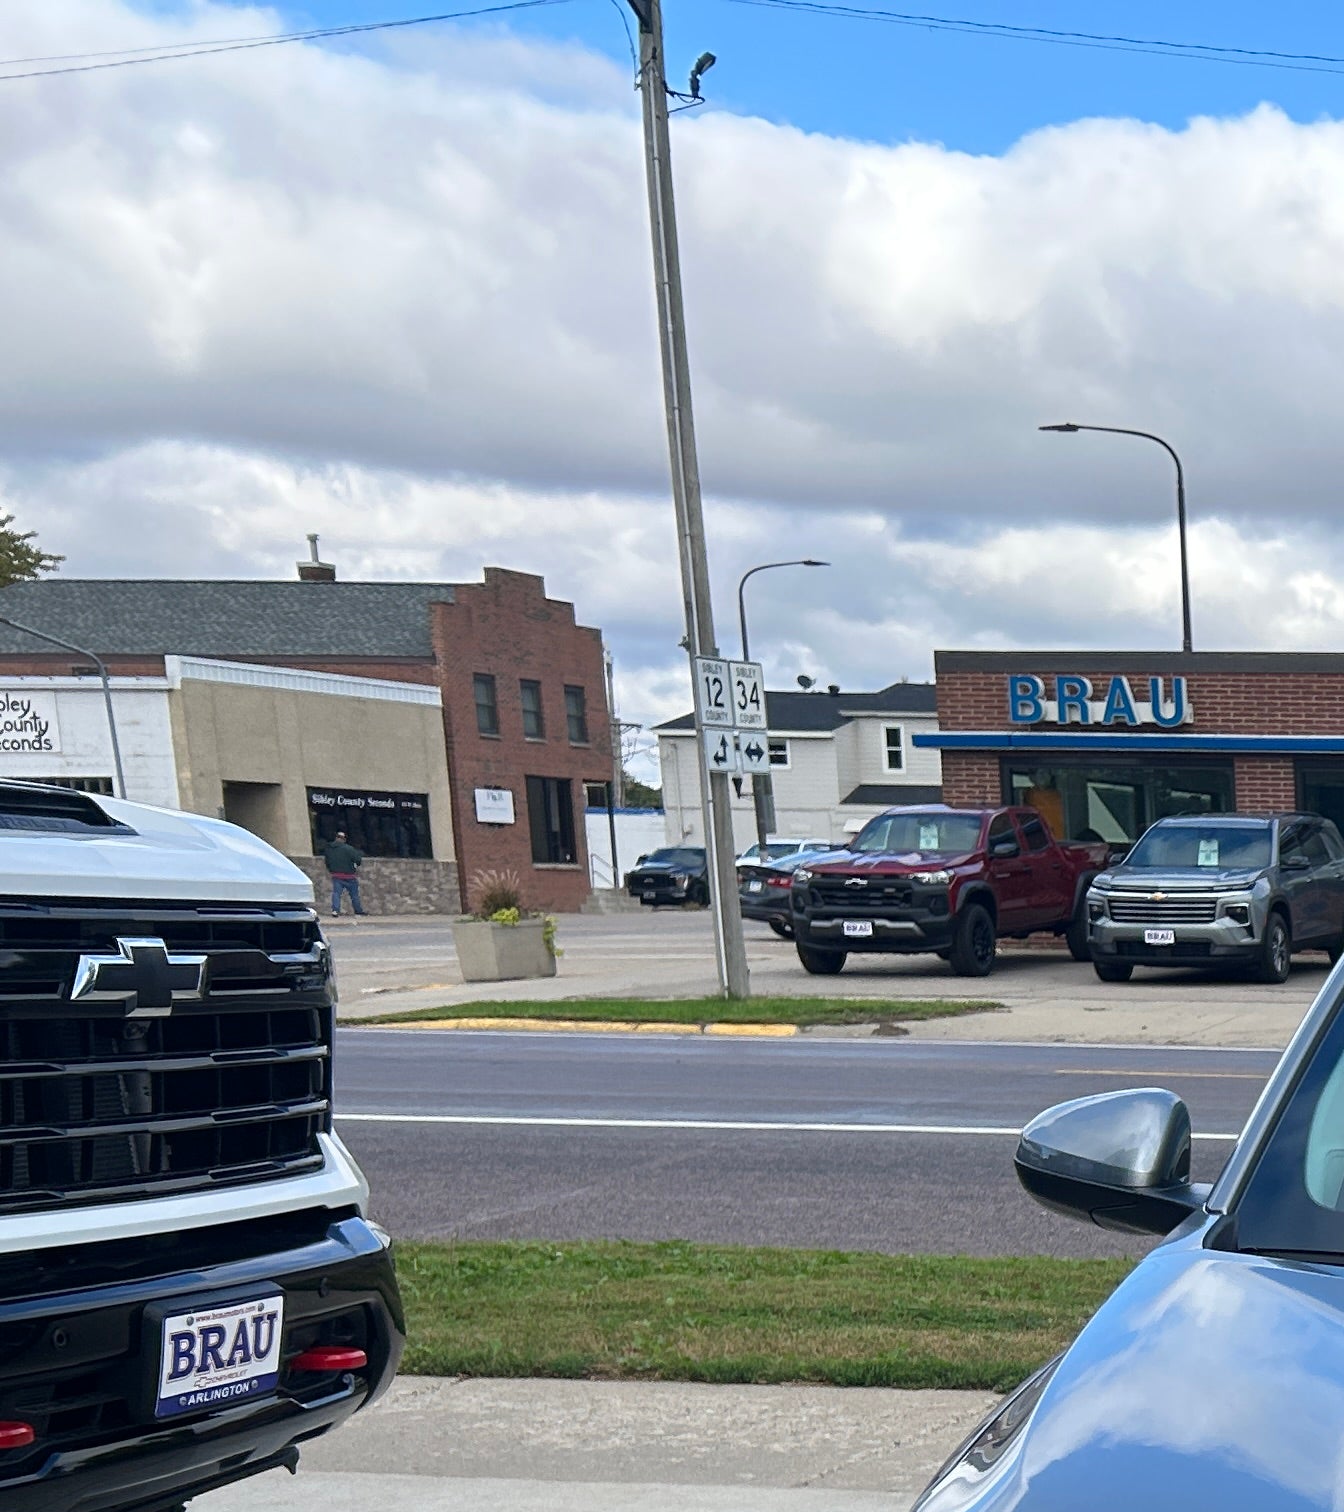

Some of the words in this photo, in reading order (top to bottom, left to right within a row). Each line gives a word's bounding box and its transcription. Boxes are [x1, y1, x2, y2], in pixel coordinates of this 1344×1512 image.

[705, 676, 725, 708] 12
[736, 680, 760, 712] 34
[1008, 674, 1190, 728] BRAU
[0, 734, 53, 751] conds
[166, 1310, 279, 1384] BRAU
[187, 1381, 251, 1406] ARLINGTON
